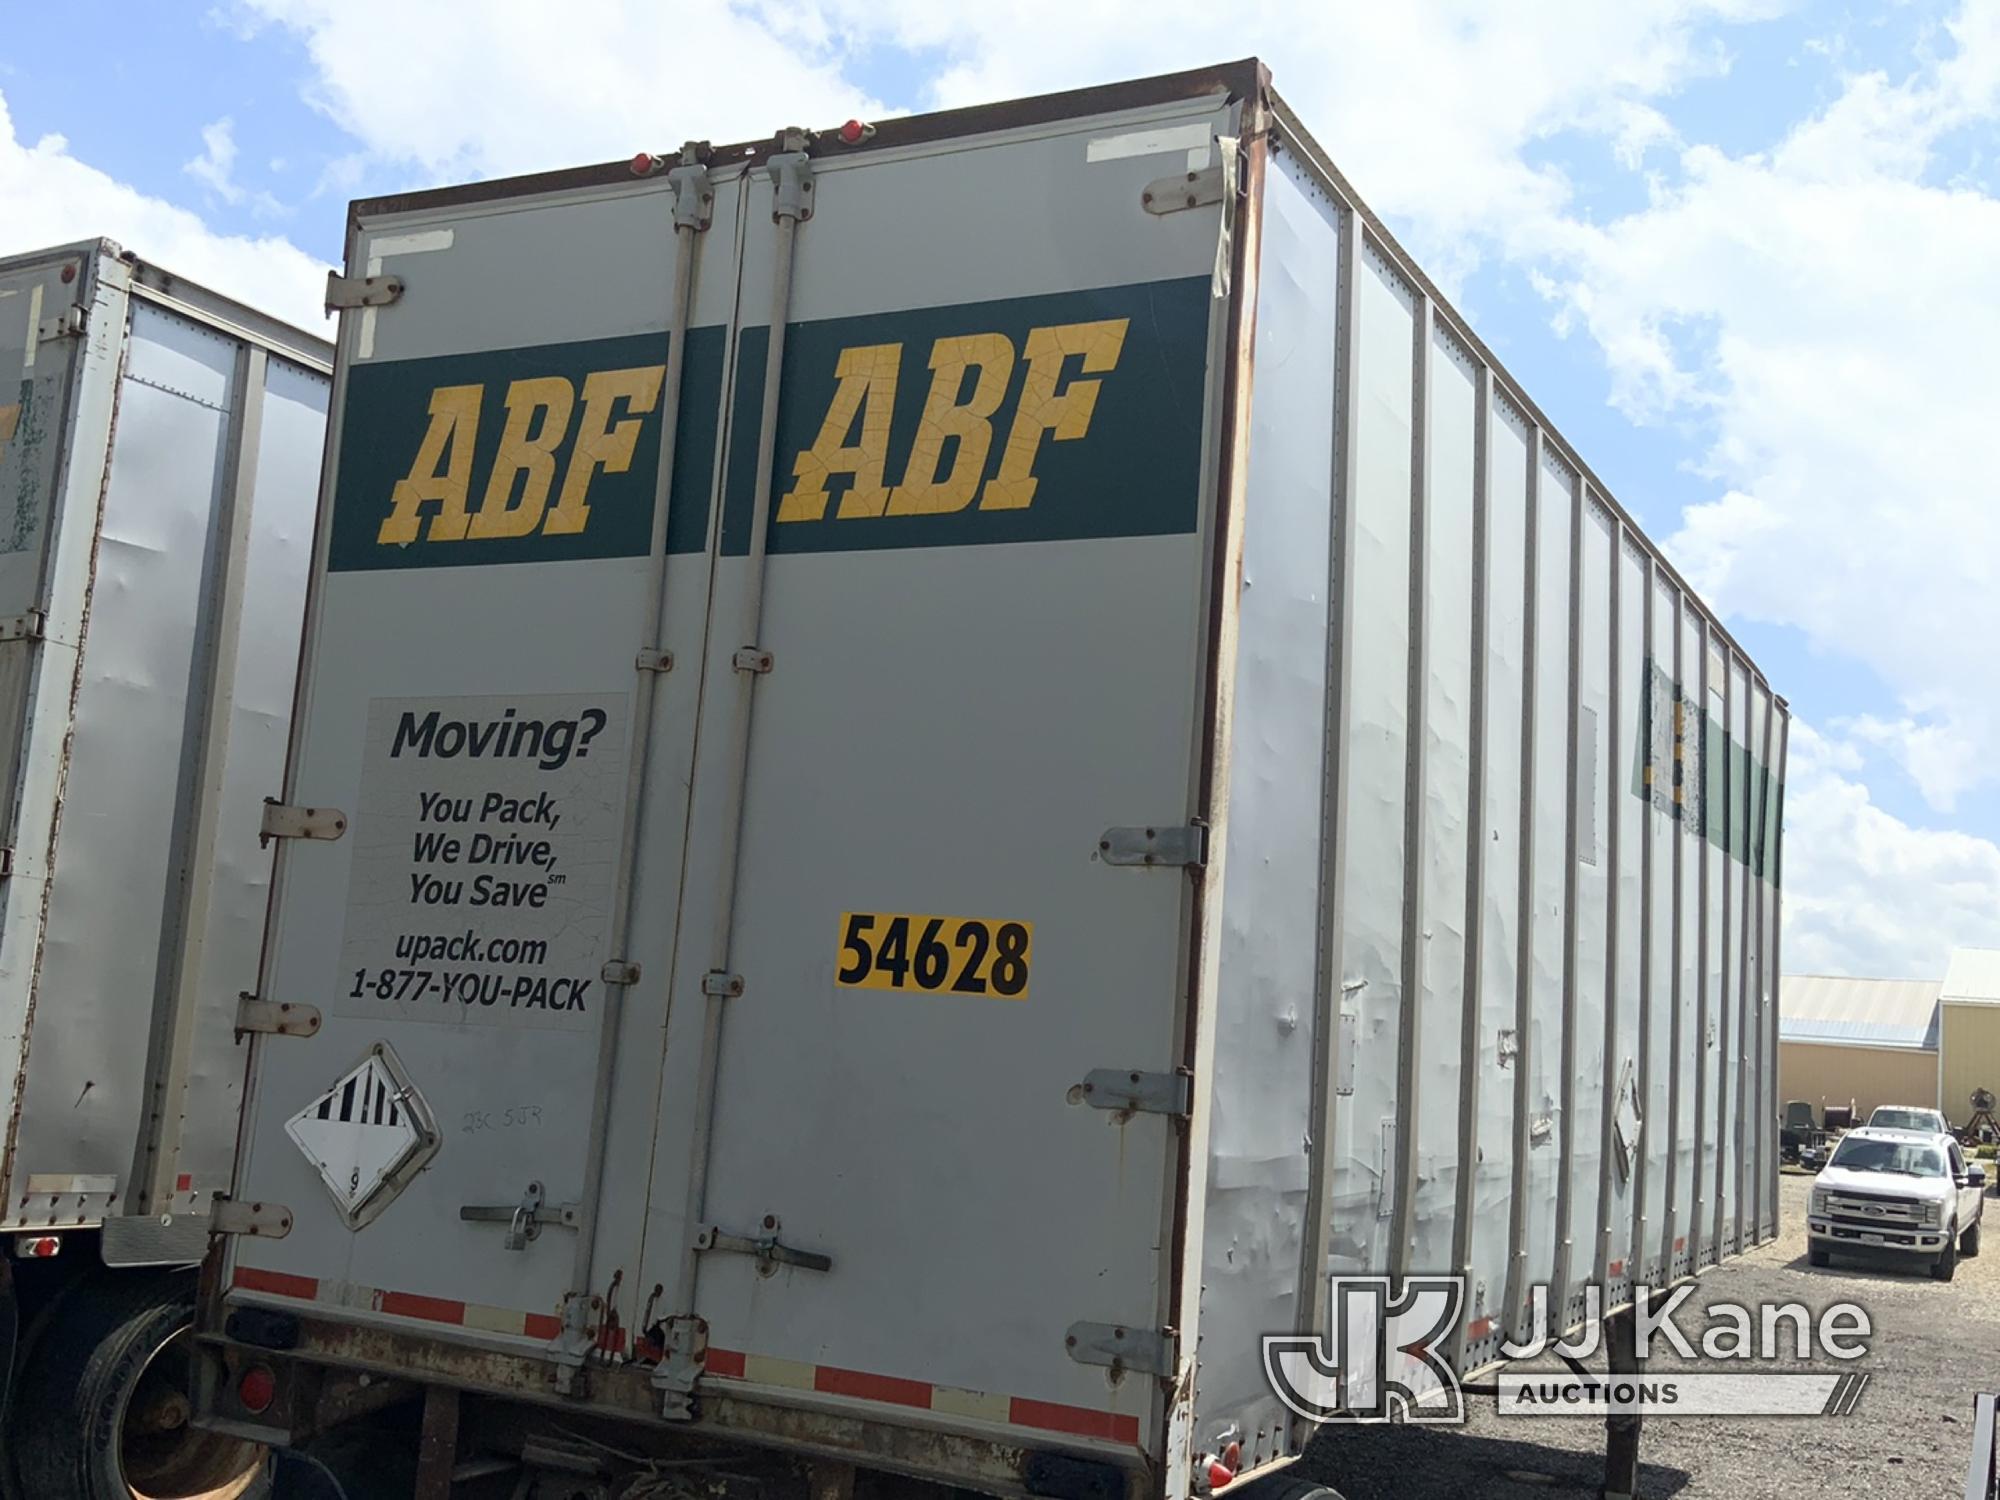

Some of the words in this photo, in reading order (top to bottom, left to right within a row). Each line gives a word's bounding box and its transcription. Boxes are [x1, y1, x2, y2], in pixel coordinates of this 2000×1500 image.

[778, 318, 1130, 522] ABF
[377, 365, 667, 545] ABF
[391, 708, 607, 770] Moving?
[419, 792, 474, 822] You
[479, 791, 561, 831] Pack,
[413, 832, 461, 863] We
[468, 832, 557, 872] Drive,
[410, 873, 464, 905] You
[395, 929, 547, 965] upack.com
[838, 914, 1029, 996] 54628
[349, 967, 592, 1012] 1-877-YOU-PACK
[350, 1171, 359, 1191] 9
